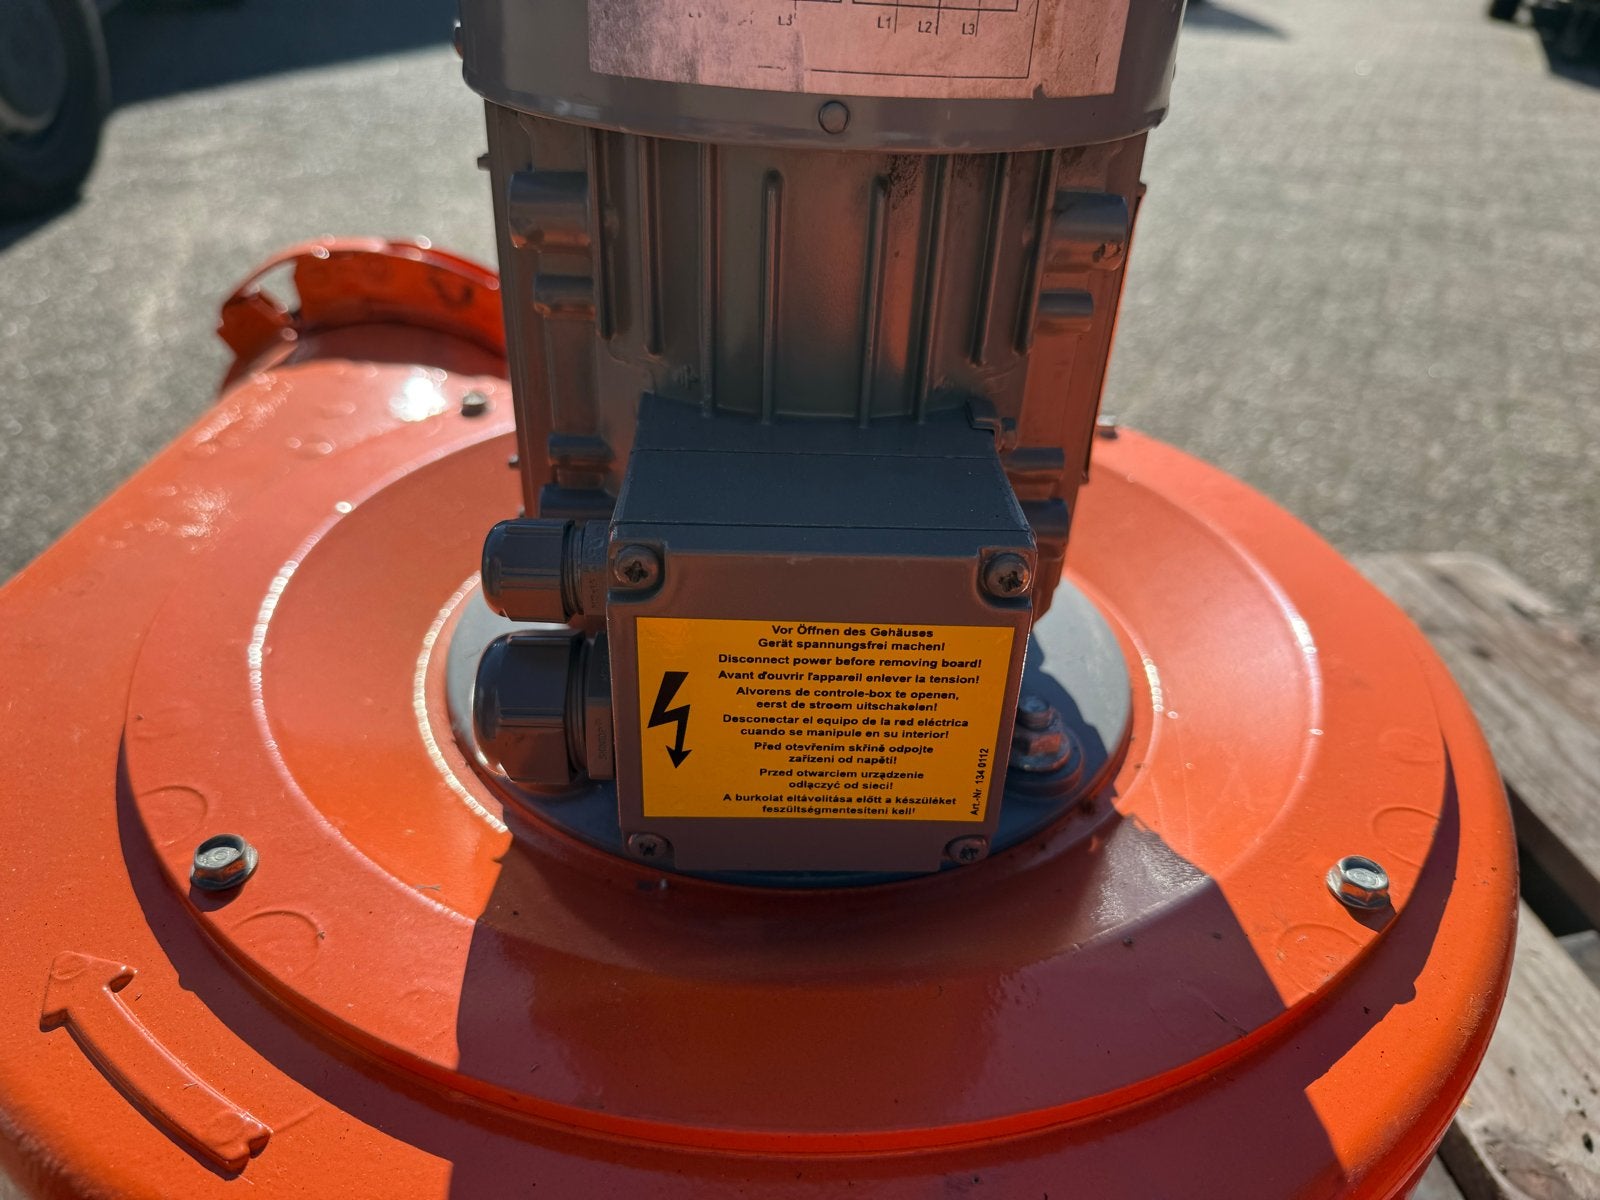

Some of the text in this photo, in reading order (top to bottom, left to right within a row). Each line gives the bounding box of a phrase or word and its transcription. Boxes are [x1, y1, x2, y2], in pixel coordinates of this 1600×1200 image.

[877, 16, 892, 30] L1
[918, 20, 933, 35] L2
[961, 22, 976, 36] L3
[771, 623, 934, 638] Vor Öffnen des Gehäuses
[757, 637, 946, 652] Gerät spannungsfrei machen!
[718, 653, 982, 670] Disconnect power before removing board!
[717, 669, 755, 680] Avant
[865, 673, 913, 683] enlever
[914, 674, 926, 684] la
[929, 674, 980, 685] tension!
[735, 686, 960, 701] Alvorens de controle-box te openen,
[755, 699, 938, 712] eerst de stroom uitschakelen!
[722, 713, 969, 728] Desconectar el equipo de la red eléctrica
[740, 727, 950, 739] cuando se manipule en su interior!
[753, 741, 782, 751] Před
[888, 744, 934, 756] odpojte
[837, 755, 854, 764] od
[978, 748, 989, 768] 0112
[759, 767, 794, 777] Przed
[796, 769, 858, 778] otwarciem
[975, 770, 985, 784] 134
[843, 781, 859, 790] od
[861, 781, 894, 791] sieci!
[722, 793, 733, 802] A
[735, 793, 784, 802] burkolat
